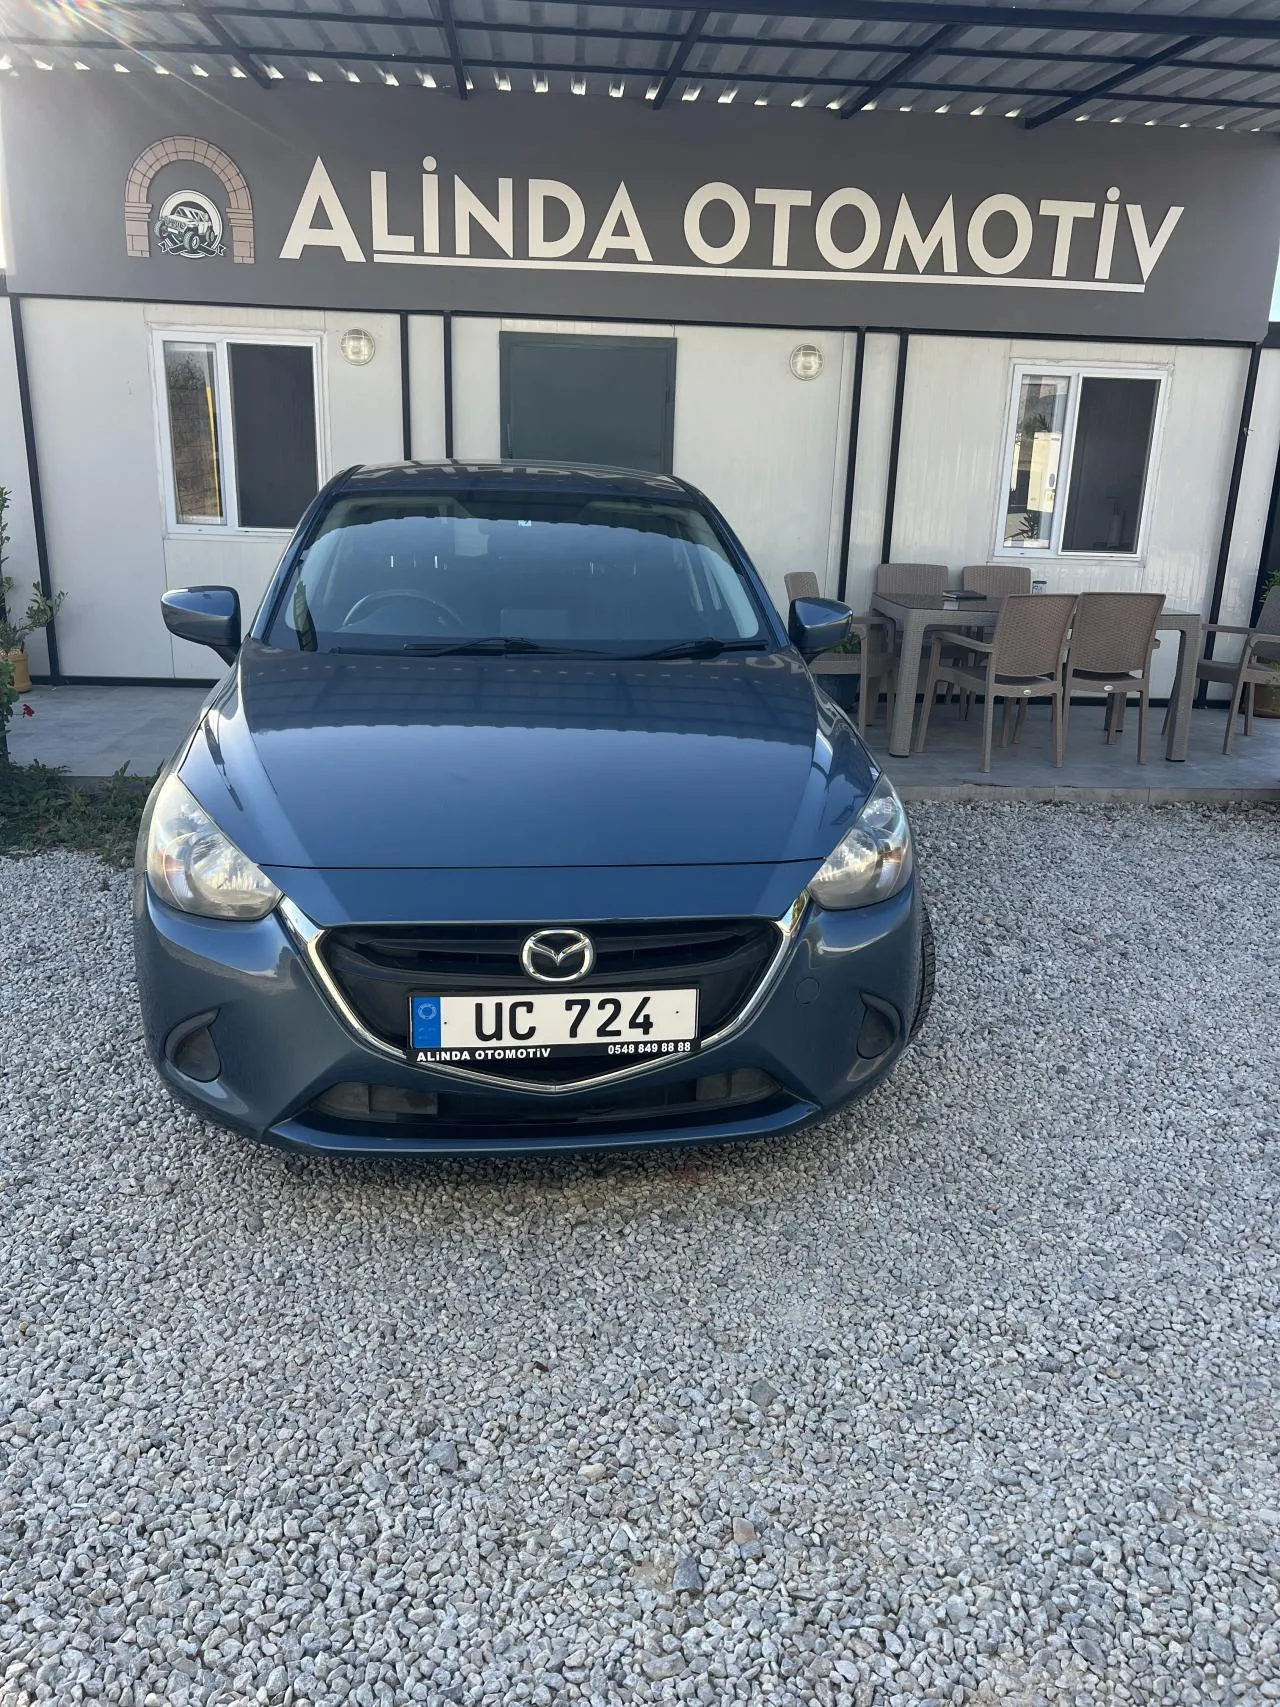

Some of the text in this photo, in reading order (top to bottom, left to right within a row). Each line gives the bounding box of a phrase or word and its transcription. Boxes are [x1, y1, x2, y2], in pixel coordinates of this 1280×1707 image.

[279, 155, 1185, 283] ALİNDA OTOMOTİV
[475, 996, 654, 1042] UC 724
[607, 1041, 691, 1055] 0548 849 88 88
